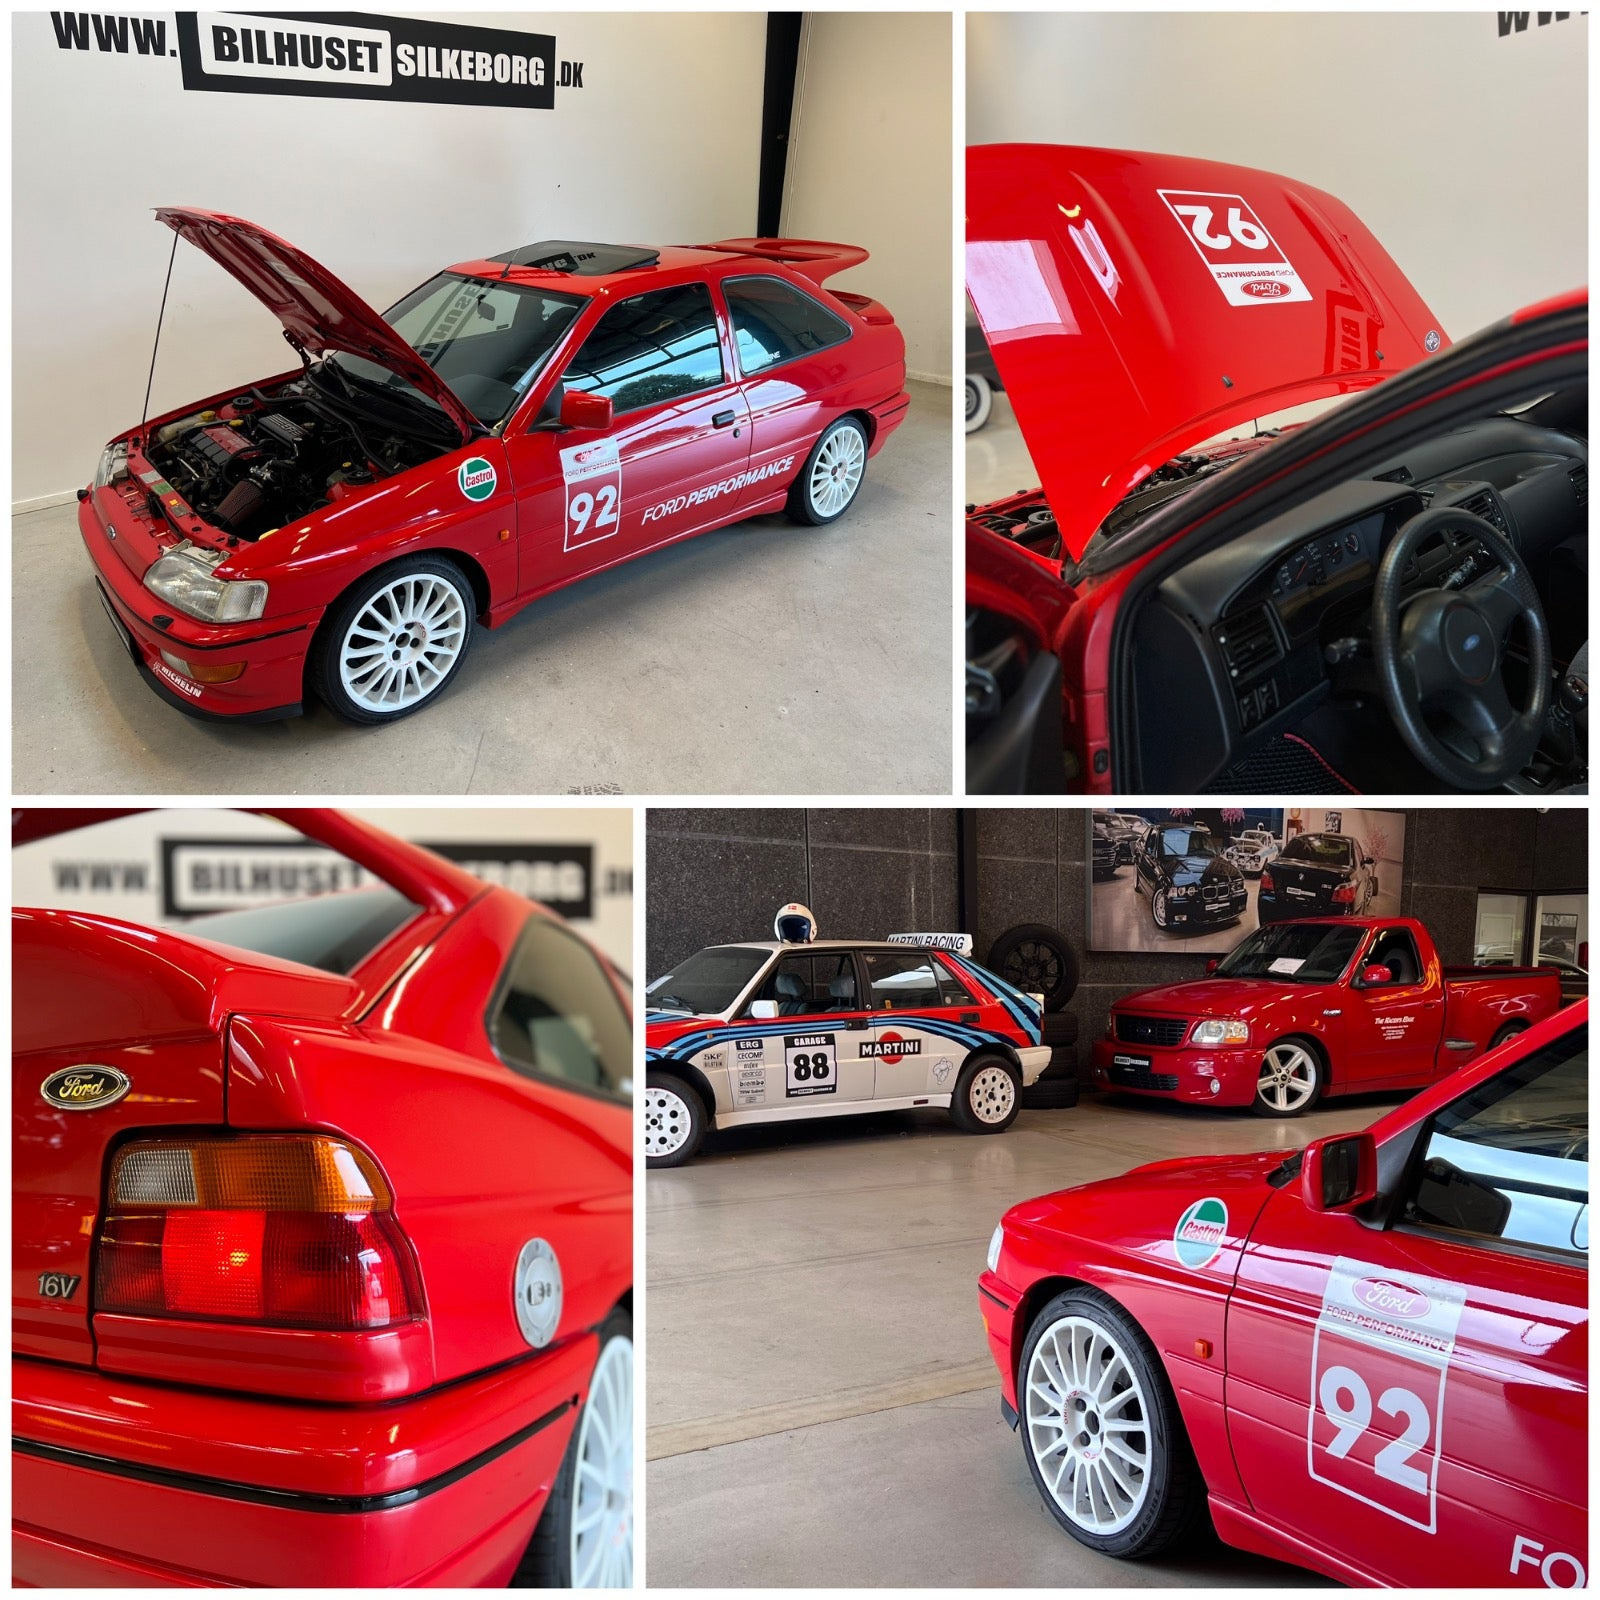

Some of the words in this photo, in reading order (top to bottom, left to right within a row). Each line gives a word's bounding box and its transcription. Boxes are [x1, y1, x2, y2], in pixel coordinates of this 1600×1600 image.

[50, 12, 178, 58] WWW.
[211, 24, 382, 74] BILHUSET
[396, 43, 545, 87] SILKEBORG
[555, 60, 584, 89] .DK
[1173, 204, 1269, 250] 92
[1215, 270, 1275, 279] PERFORMANCE
[1250, 282, 1281, 297] Ford
[465, 468, 493, 488] Castrol
[641, 495, 687, 526] FORD
[685, 455, 796, 509] PERFORMANCE
[569, 484, 618, 536] 92
[161, 666, 202, 698] MICHELIN
[925, 936, 965, 949] RACING
[740, 1040, 759, 1049] ERG
[794, 1036, 826, 1046] GARAGE
[861, 1041, 919, 1056] MARTINI
[703, 1052, 723, 1060] SKF
[737, 1051, 763, 1060] CECOMP
[793, 1052, 830, 1081] 88
[58, 1074, 105, 1098] Ford
[1182, 1220, 1224, 1243] Castrol
[38, 1273, 79, 1298] 16V
[1365, 1280, 1416, 1314] Ford
[1326, 1304, 1355, 1322] FORD
[1354, 1313, 1450, 1353] PERFORMANCE
[1319, 1365, 1430, 1496] 92
[1509, 1534, 1588, 1588] FO
